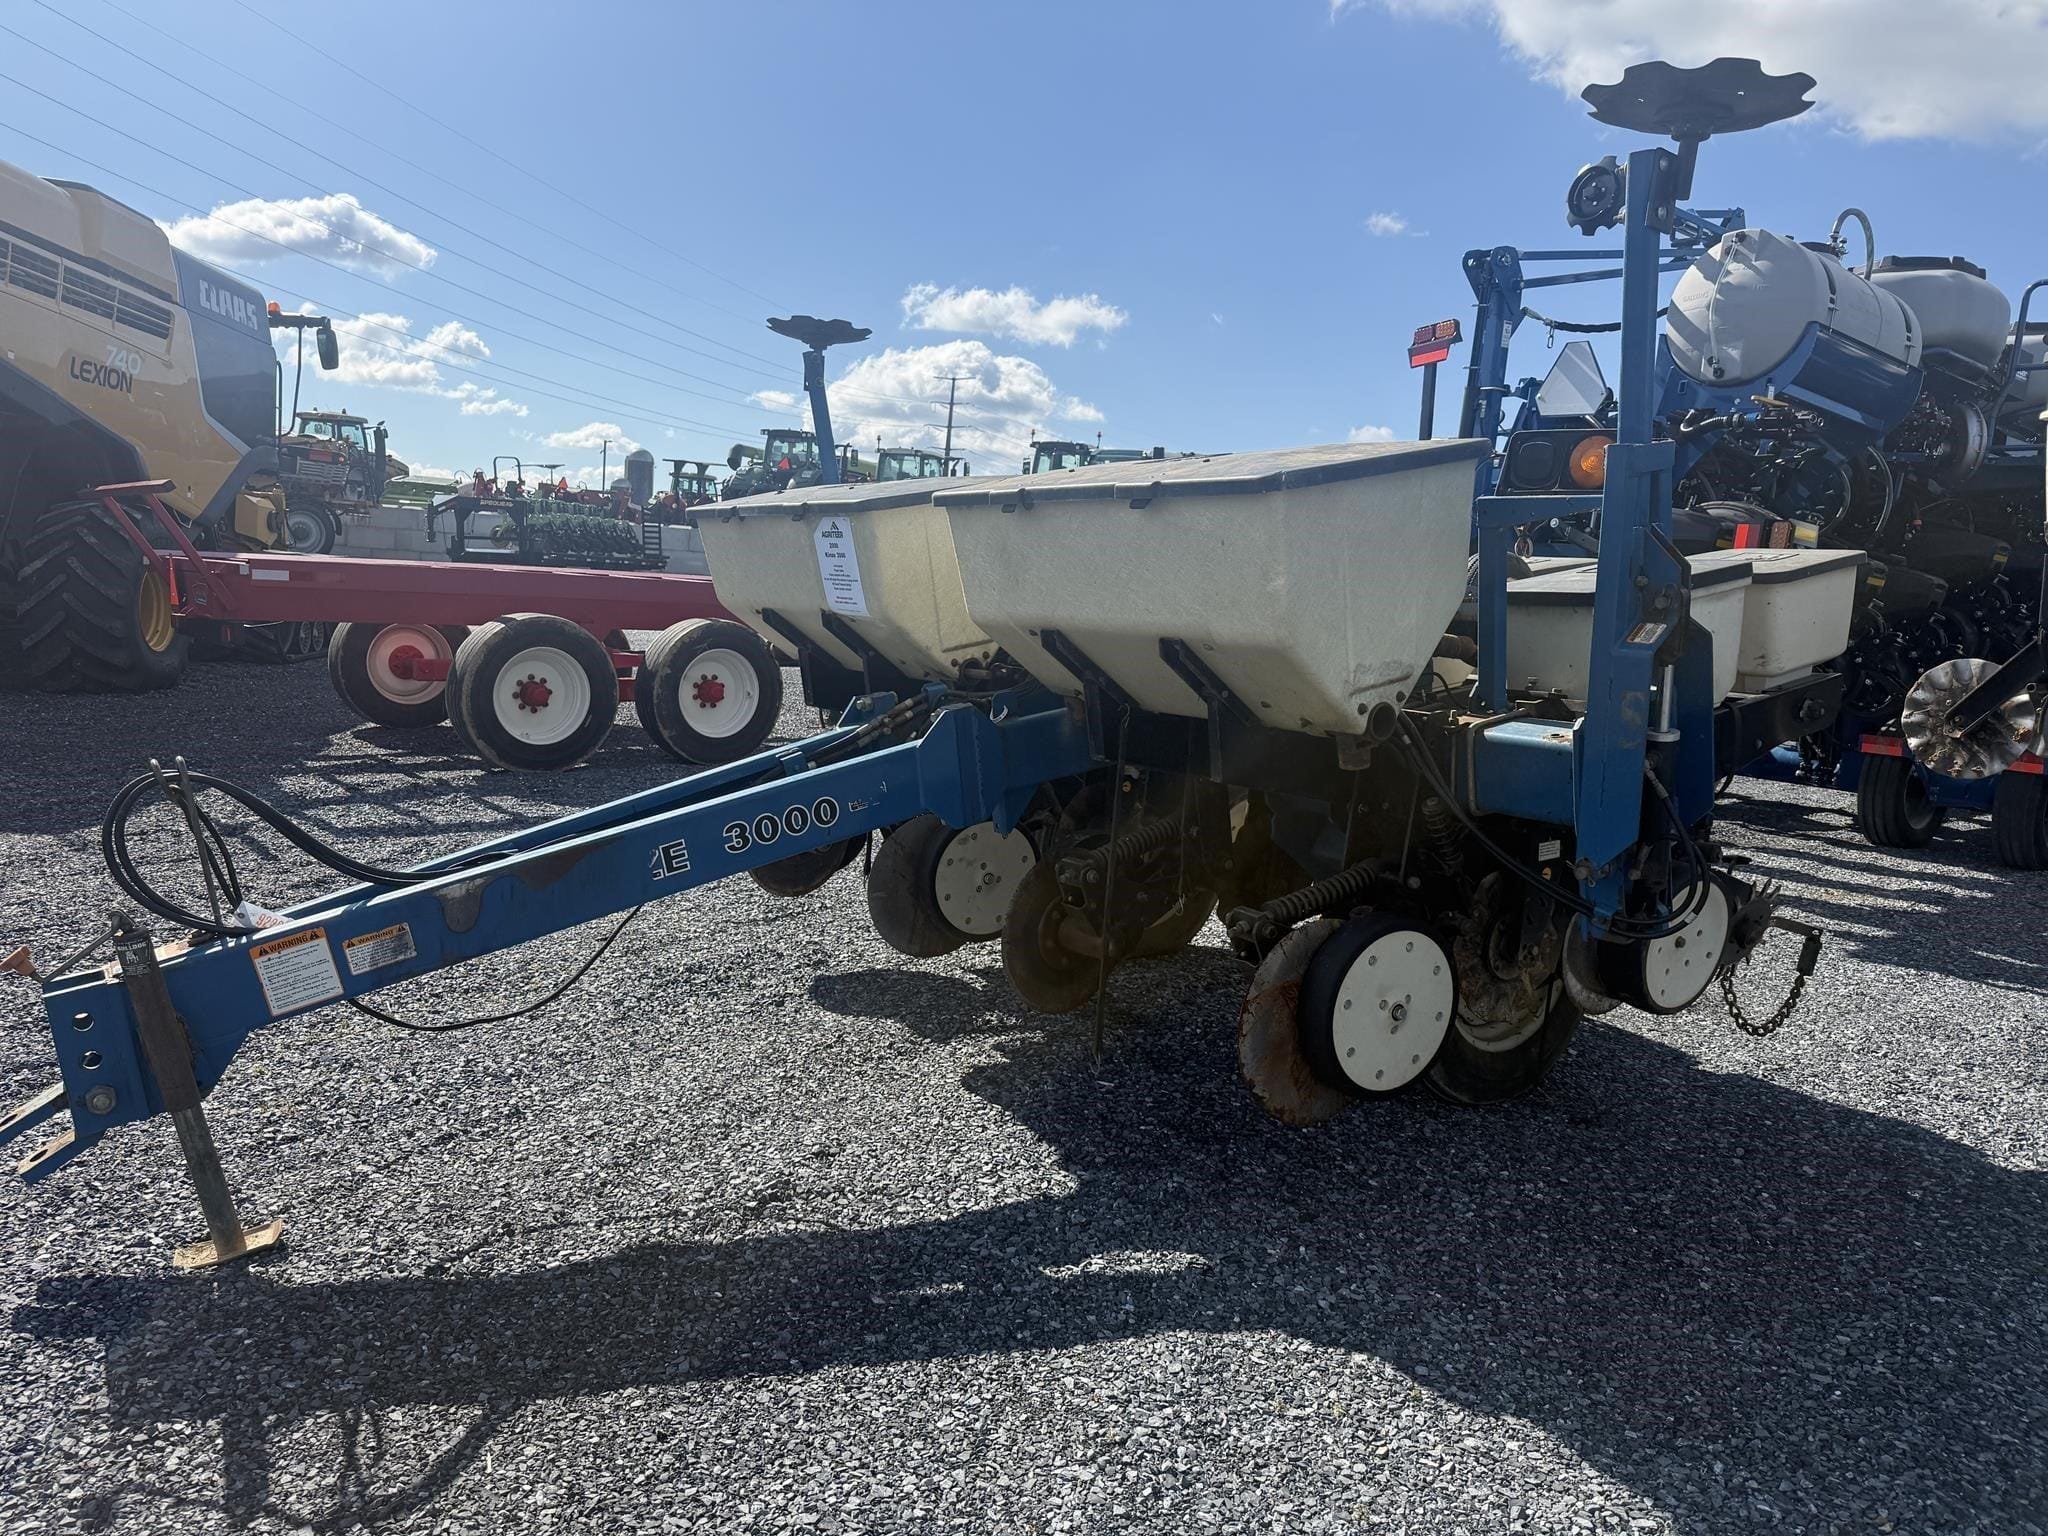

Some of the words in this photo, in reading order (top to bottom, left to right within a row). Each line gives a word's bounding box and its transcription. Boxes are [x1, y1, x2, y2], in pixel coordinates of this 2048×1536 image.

[199, 279, 258, 331] CLAAS
[70, 356, 133, 394] LEXION
[106, 344, 142, 375] 740
[722, 795, 840, 854] 3000
[268, 933, 309, 953] WARNING
[357, 929, 394, 944] WARNING
